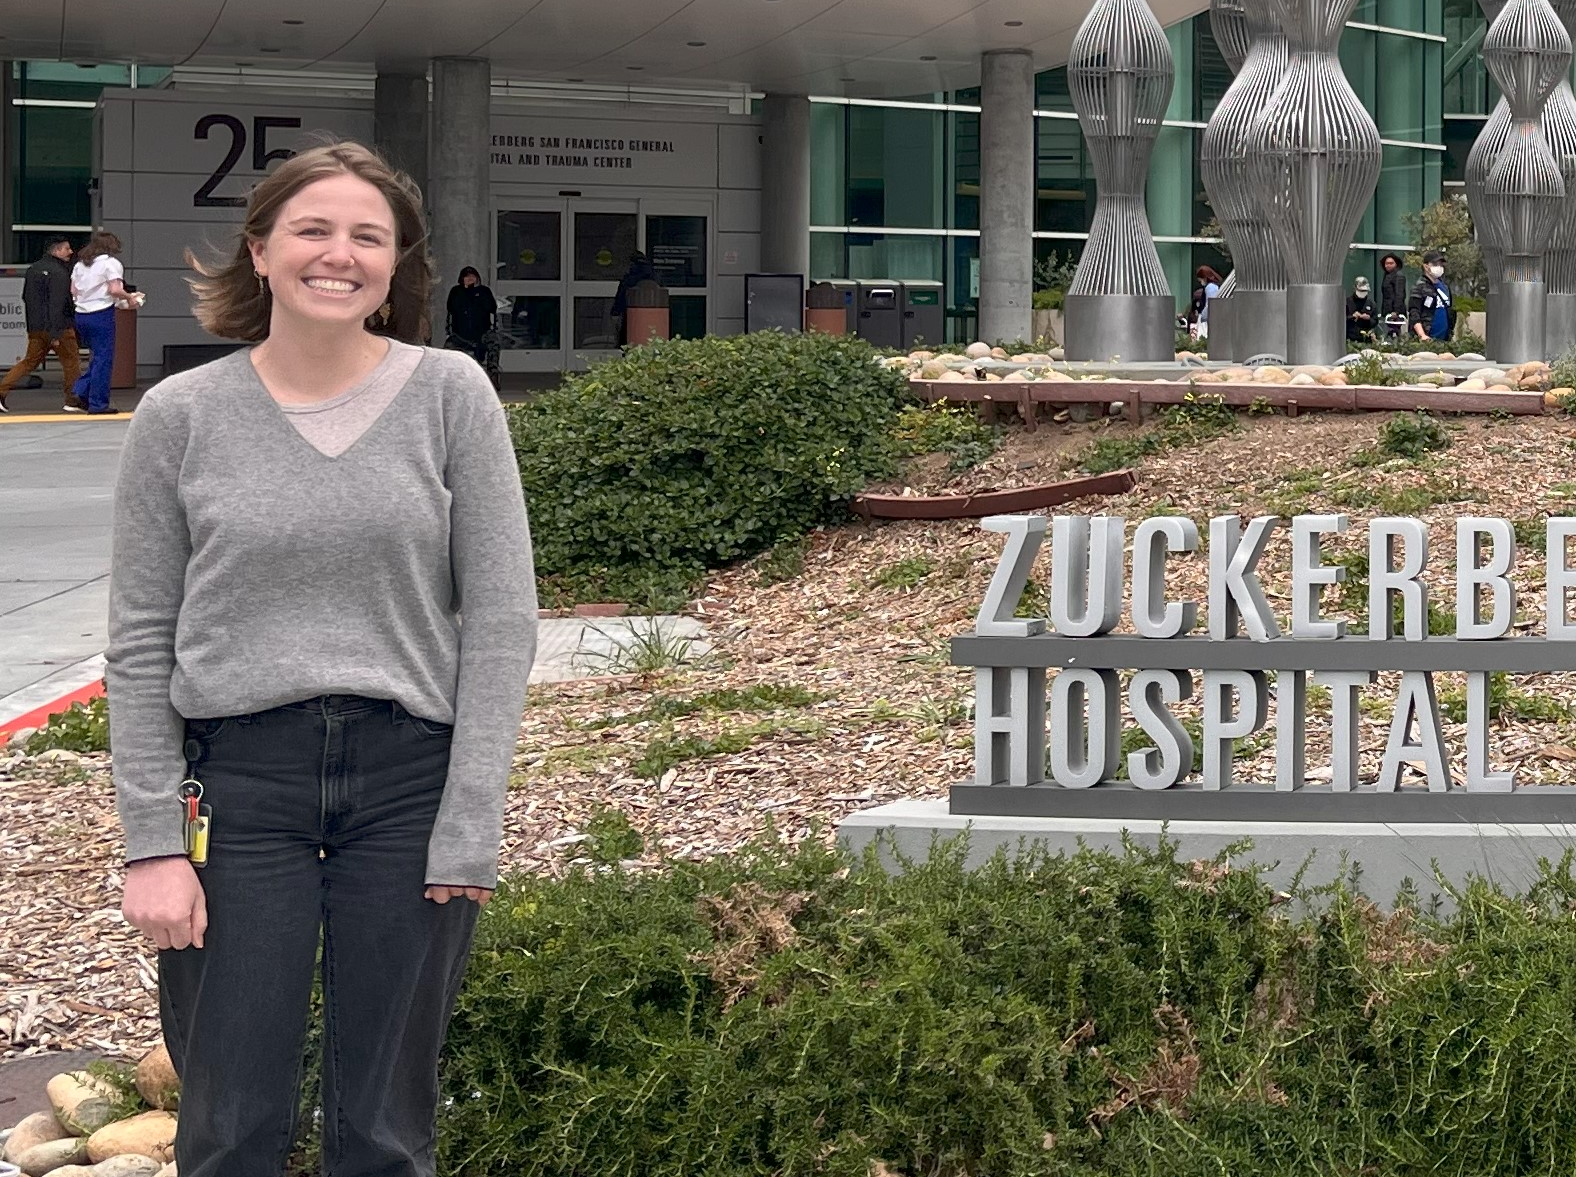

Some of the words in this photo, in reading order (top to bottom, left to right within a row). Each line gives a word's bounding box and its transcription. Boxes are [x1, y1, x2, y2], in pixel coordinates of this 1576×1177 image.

[490, 135, 535, 148] ERBERG
[540, 137, 560, 149] SAN
[565, 137, 625, 151] FRANCISCO
[629, 140, 675, 153] GENERAL
[518, 154, 540, 166] AND
[545, 155, 589, 167] TRAUMA
[594, 156, 633, 169] CENTER
[975, 667, 1516, 792] HOSPITAL
